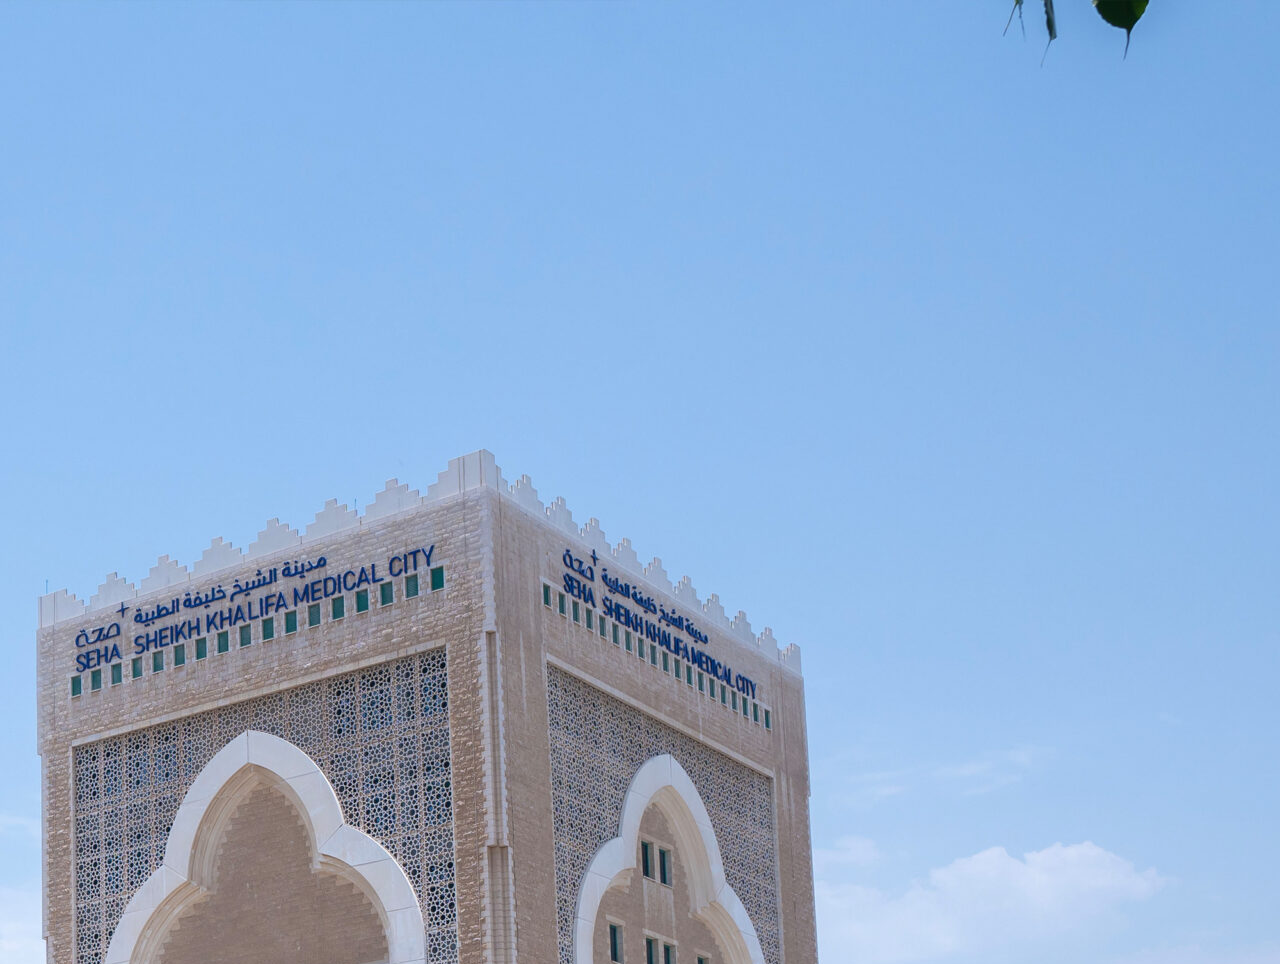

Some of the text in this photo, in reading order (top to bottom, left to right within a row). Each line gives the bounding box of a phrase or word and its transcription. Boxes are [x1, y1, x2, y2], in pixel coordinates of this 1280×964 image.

[563, 548, 595, 582] صحة
[133, 556, 328, 627] مدينة الشيخ خليفة الطبية
[134, 545, 435, 655] SHEIKH KHALIFA MEDICAL CITY
[563, 573, 597, 608] SEHA
[75, 622, 120, 648] صحة
[602, 595, 757, 700] SHEIKH KHALIFA MEDICAL CITY
[76, 643, 122, 673] SEHA
